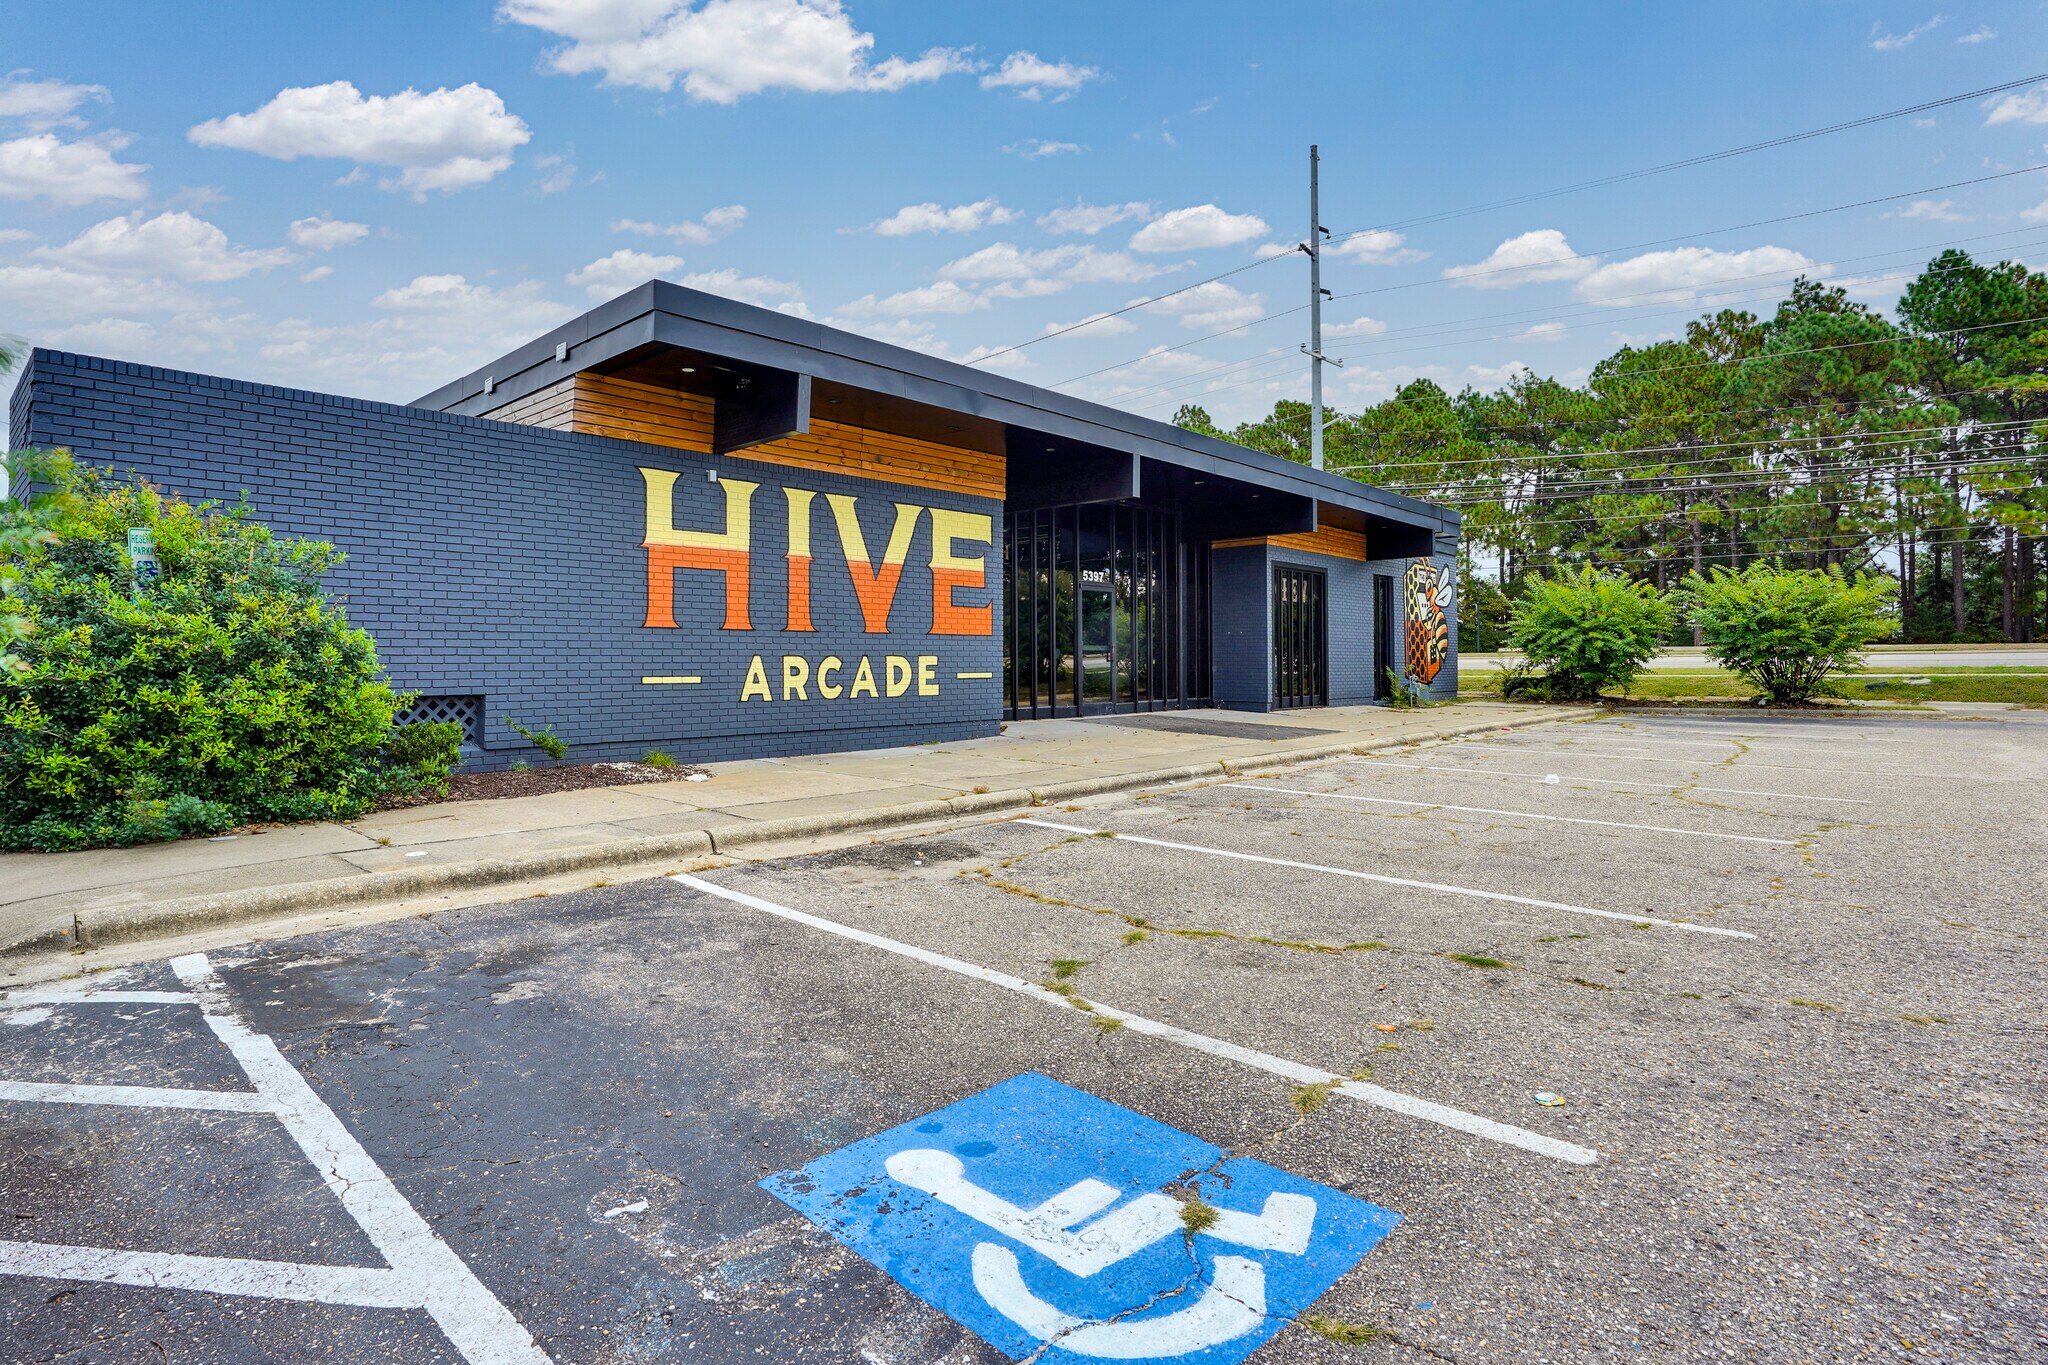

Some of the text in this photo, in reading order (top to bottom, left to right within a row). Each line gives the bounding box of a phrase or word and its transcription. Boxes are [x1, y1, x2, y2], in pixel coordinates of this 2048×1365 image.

[637, 466, 993, 636] HIVE
[1082, 570, 1105, 583] 5397
[740, 654, 941, 702] ARCADE
